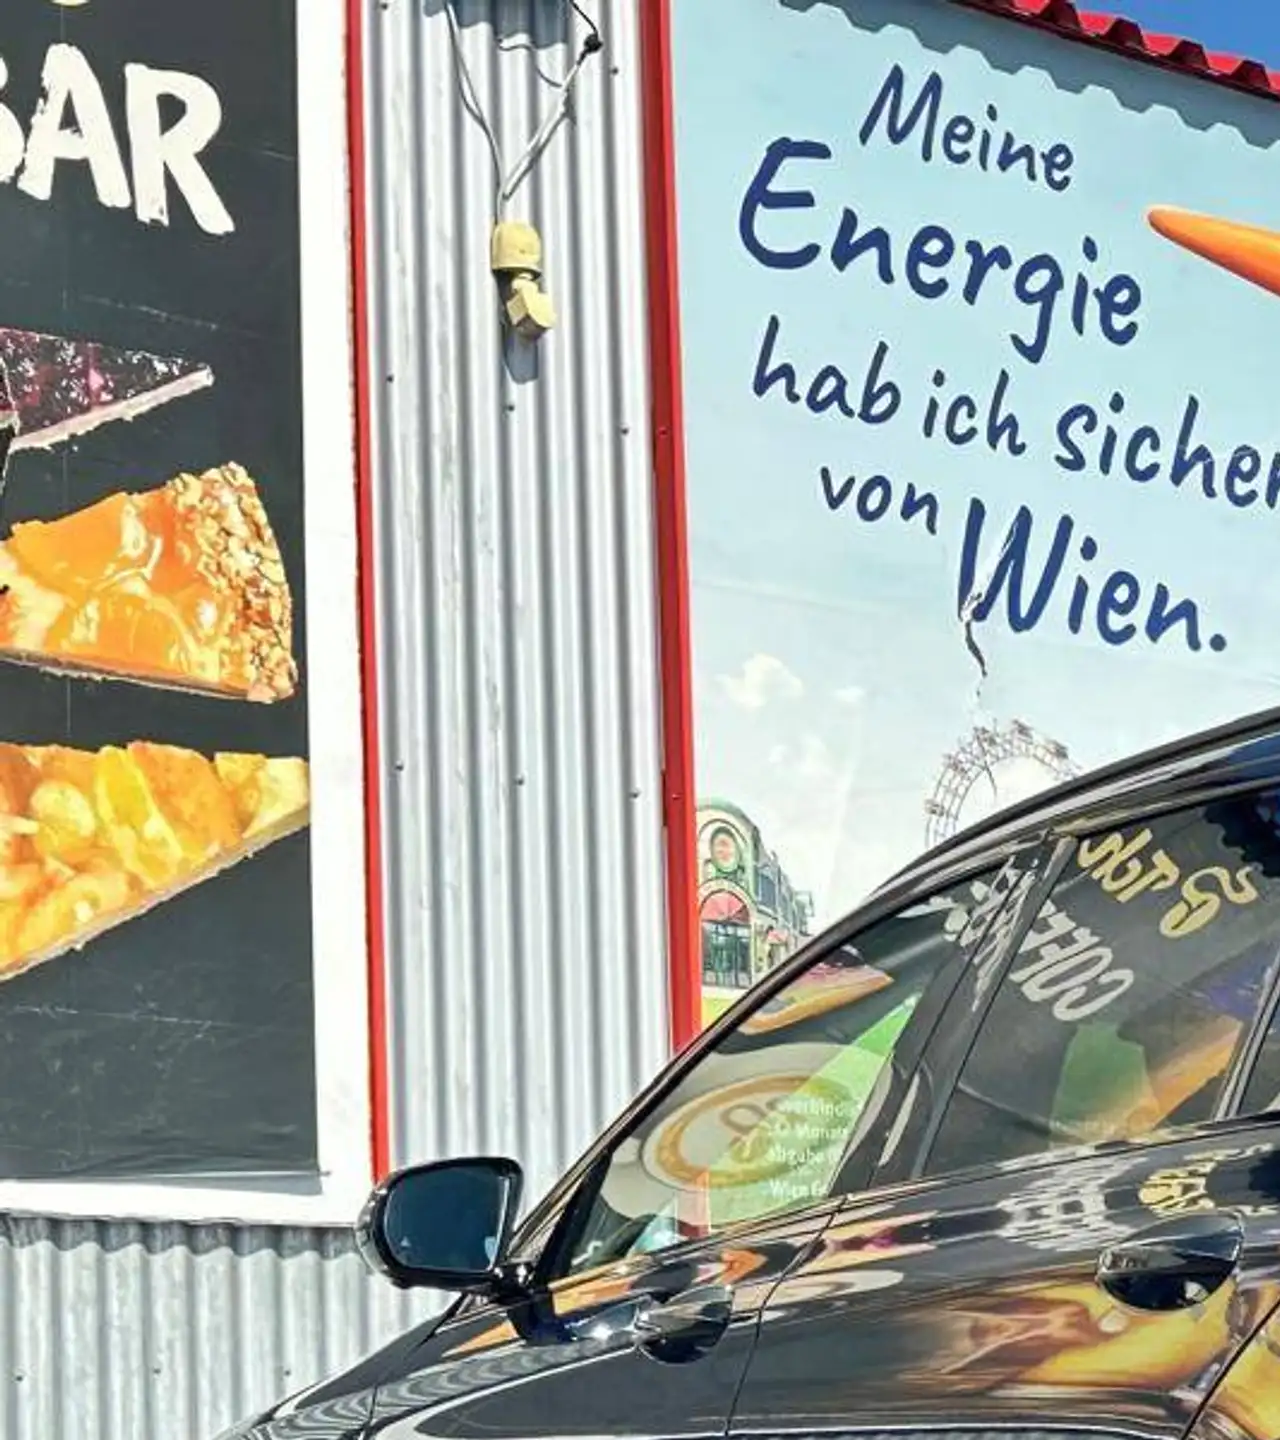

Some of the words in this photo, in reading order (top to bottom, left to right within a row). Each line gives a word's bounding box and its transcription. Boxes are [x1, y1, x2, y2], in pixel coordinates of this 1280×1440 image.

[858, 63, 1075, 192] Meine
[738, 136, 1143, 364] Energie
[752, 314, 902, 425] hab
[922, 369, 1027, 456] ich
[820, 465, 938, 535] von
[957, 497, 1228, 652] Wien.
